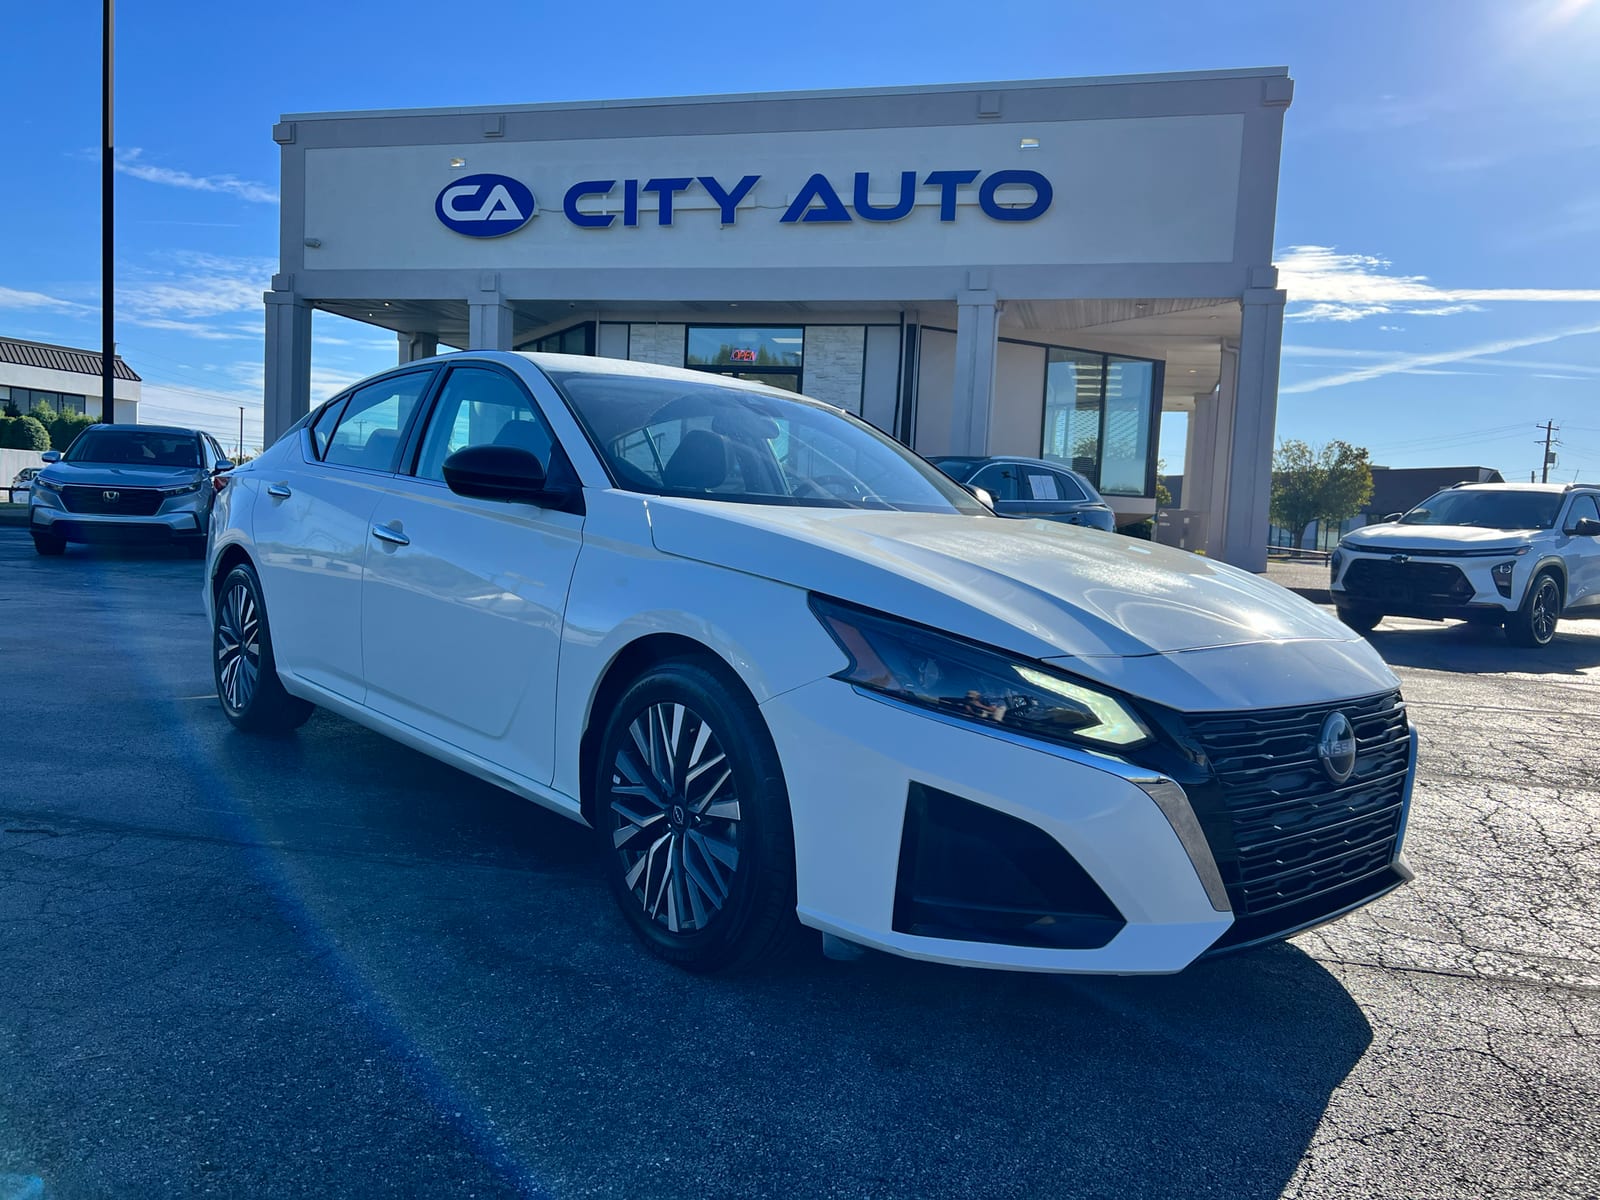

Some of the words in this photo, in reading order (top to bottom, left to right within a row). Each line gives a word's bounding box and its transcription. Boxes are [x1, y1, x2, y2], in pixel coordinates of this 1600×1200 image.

[441, 184, 525, 222] CA
[563, 175, 762, 228] CITY
[779, 169, 1054, 223] AUTO
[732, 349, 756, 361] OPEN
[1319, 741, 1354, 756] NISS
